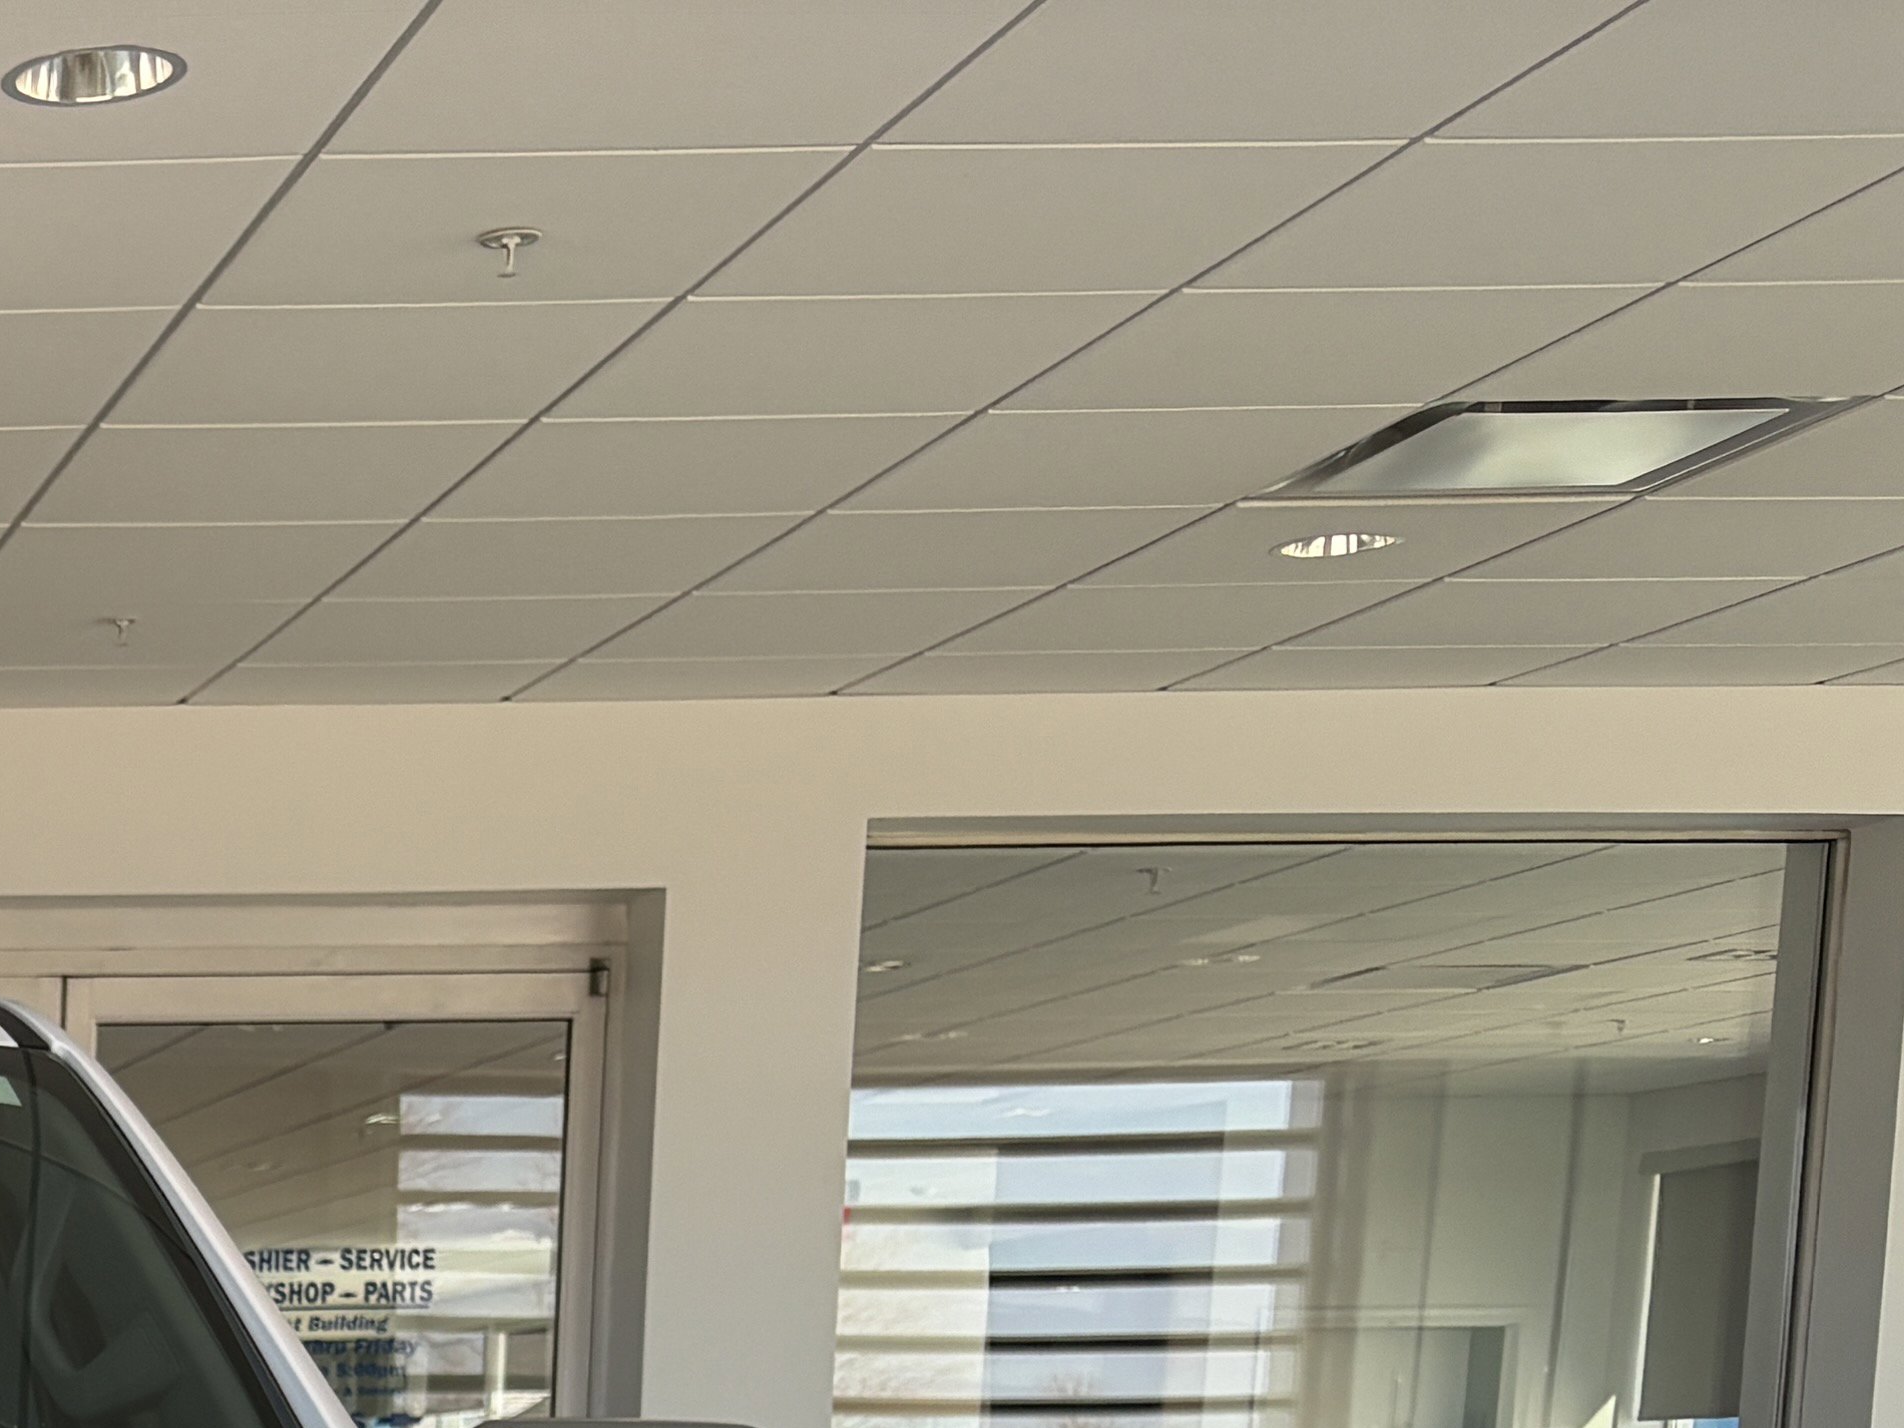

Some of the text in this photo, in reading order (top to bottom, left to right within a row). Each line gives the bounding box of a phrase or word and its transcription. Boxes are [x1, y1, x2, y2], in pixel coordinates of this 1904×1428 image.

[340, 1248, 436, 1271] SERVICE
[364, 1280, 434, 1303] PARTS
[308, 1315, 390, 1334] Building
